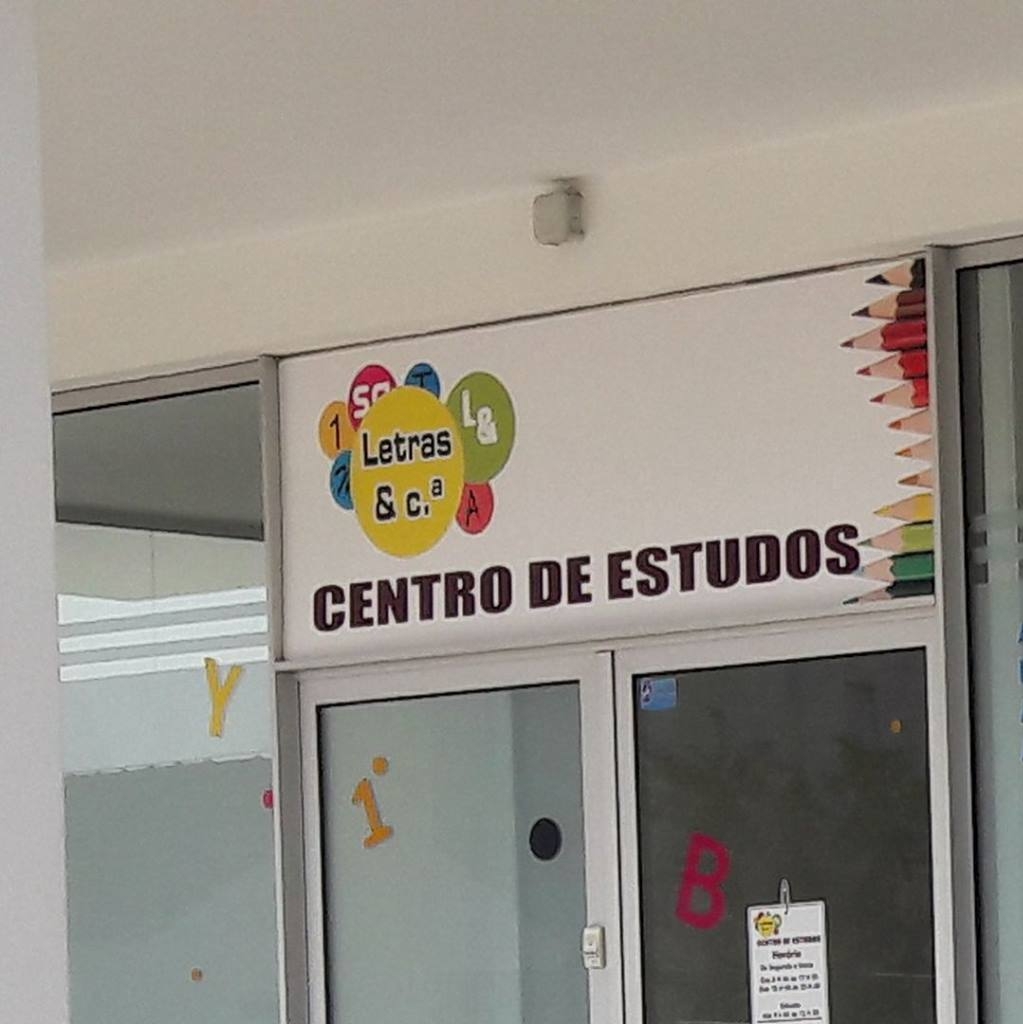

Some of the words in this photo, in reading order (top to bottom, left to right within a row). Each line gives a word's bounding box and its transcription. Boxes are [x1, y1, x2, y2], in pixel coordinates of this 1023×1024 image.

[362, 430, 452, 466] Letras
[375, 485, 396, 521] &
[313, 565, 513, 632] CENTRO
[528, 555, 593, 609] DE
[607, 523, 861, 600] ESTUDOS
[205, 657, 243, 738] Y
[675, 832, 732, 930] B
